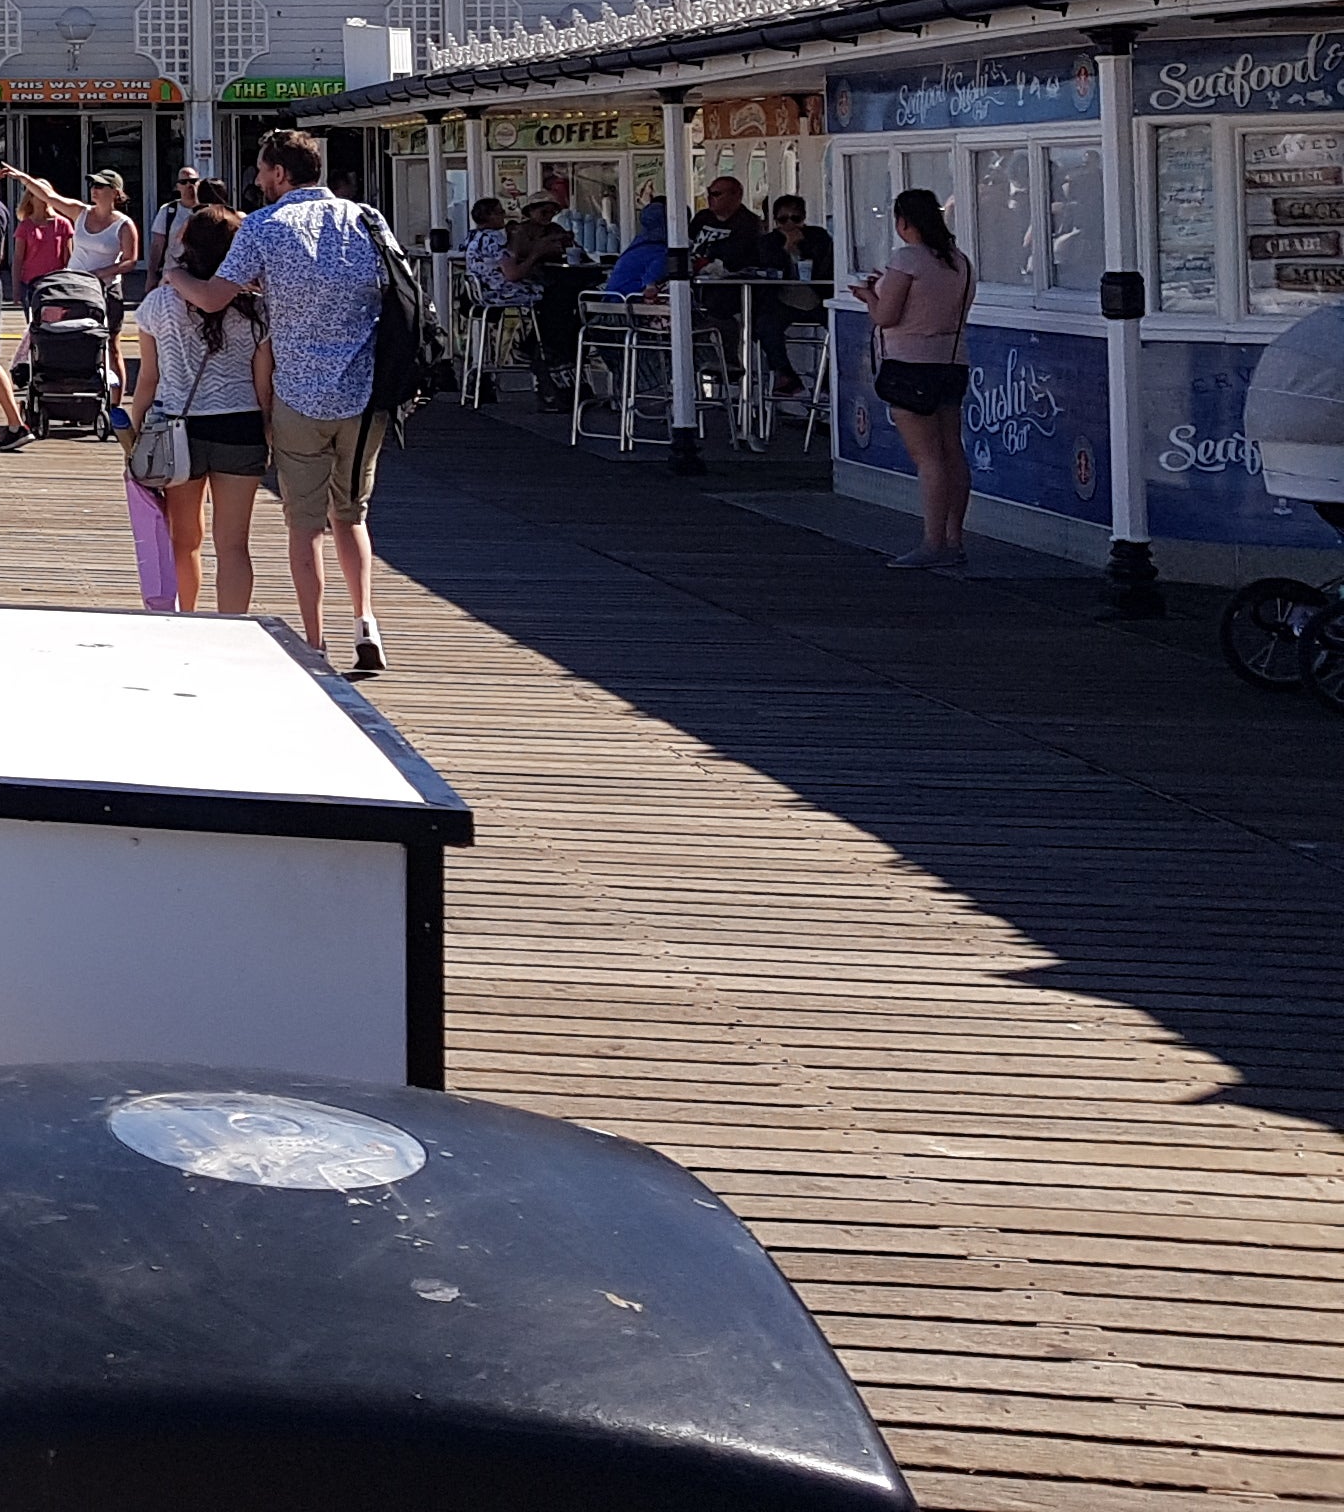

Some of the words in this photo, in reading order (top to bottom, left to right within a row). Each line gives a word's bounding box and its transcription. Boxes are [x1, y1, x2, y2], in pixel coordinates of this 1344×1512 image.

[1149, 32, 1326, 110] Seafood
[8, 80, 44, 89] THIS
[49, 80, 88, 89] WAY
[93, 80, 116, 89] TO
[122, 80, 151, 89] THE
[11, 92, 45, 101] END
[50, 92, 72, 101] OF
[78, 92, 108, 101] THE
[113, 92, 148, 101] PIER
[232, 82, 266, 98] THE
[275, 82, 344, 99] PALACE
[535, 118, 620, 147] COFFEE
[1253, 138, 1338, 161] SERVED
[967, 348, 1027, 433] Sushi
[1002, 420, 1031, 456] Bar
